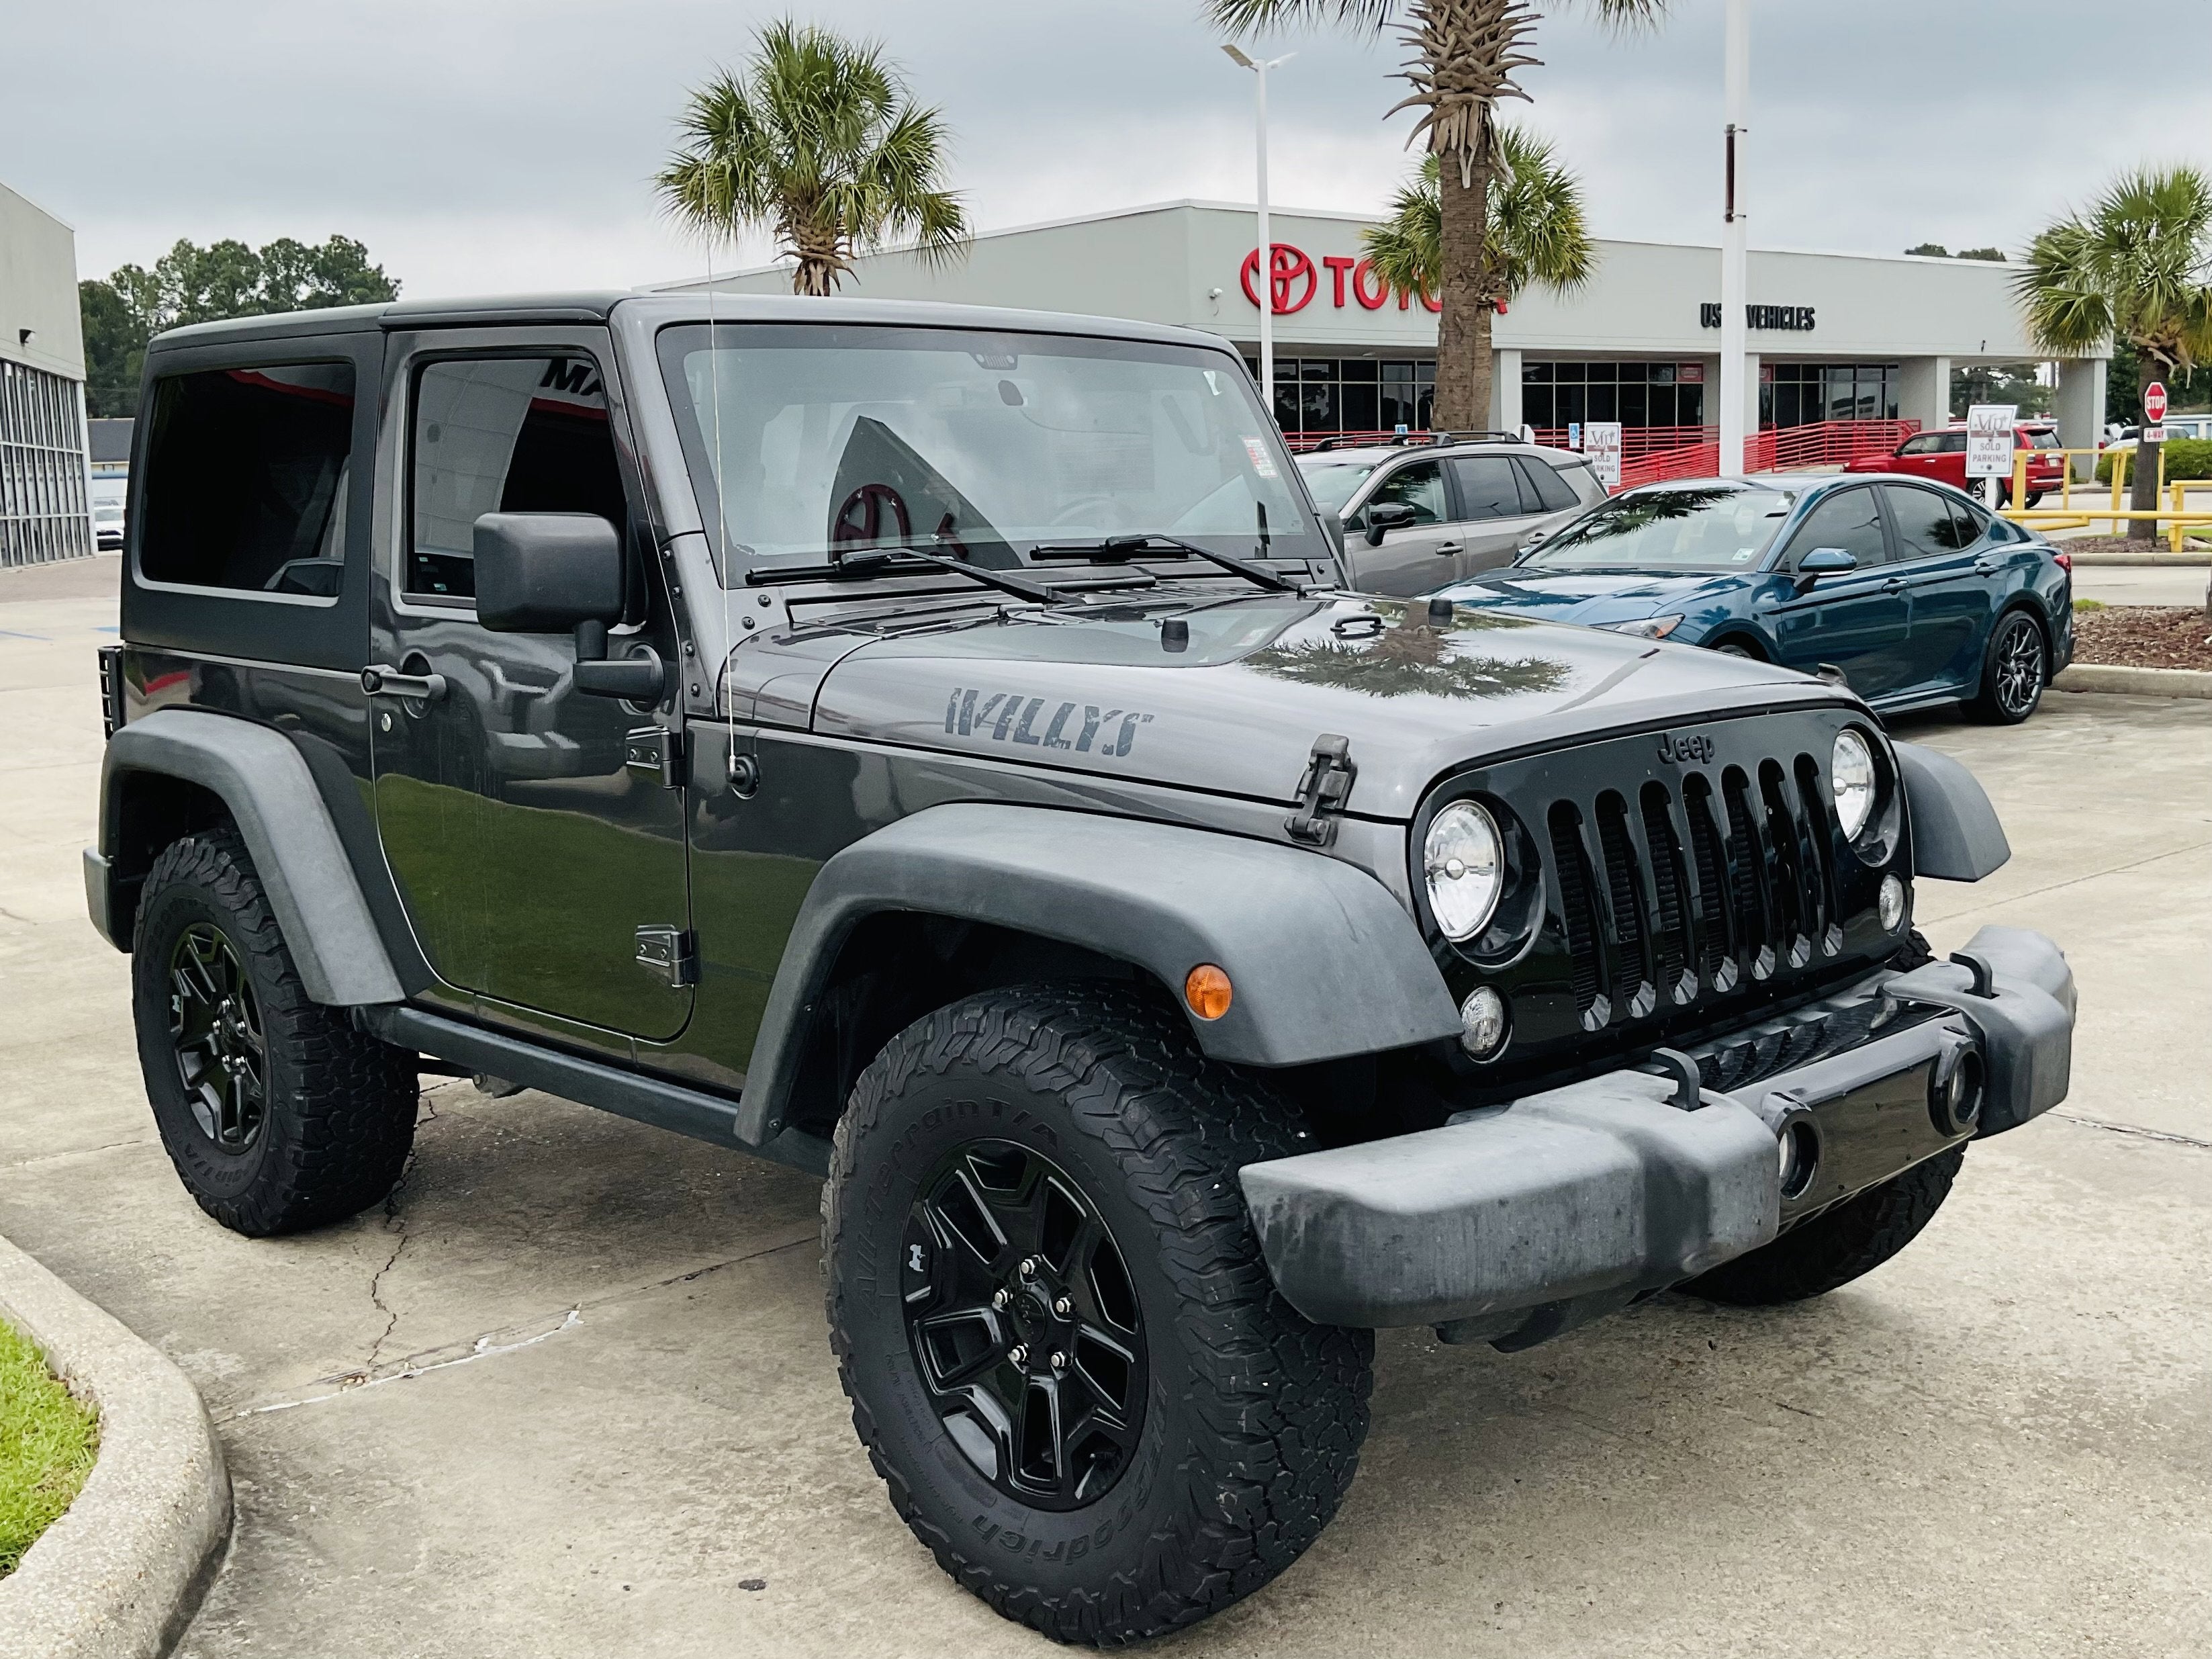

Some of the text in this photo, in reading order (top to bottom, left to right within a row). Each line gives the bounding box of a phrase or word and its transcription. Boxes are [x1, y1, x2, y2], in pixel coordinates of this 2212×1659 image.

[1745, 304, 1815, 330] VEHICLES
[2147, 396, 2165, 409] STOP
[2147, 431, 2164, 439] 4-WAY
[1980, 443, 2000, 451] SOLD
[1972, 454, 2007, 462] PARKING
[945, 687, 1154, 757] WILLYS
[1657, 732, 1715, 764] Jeep
